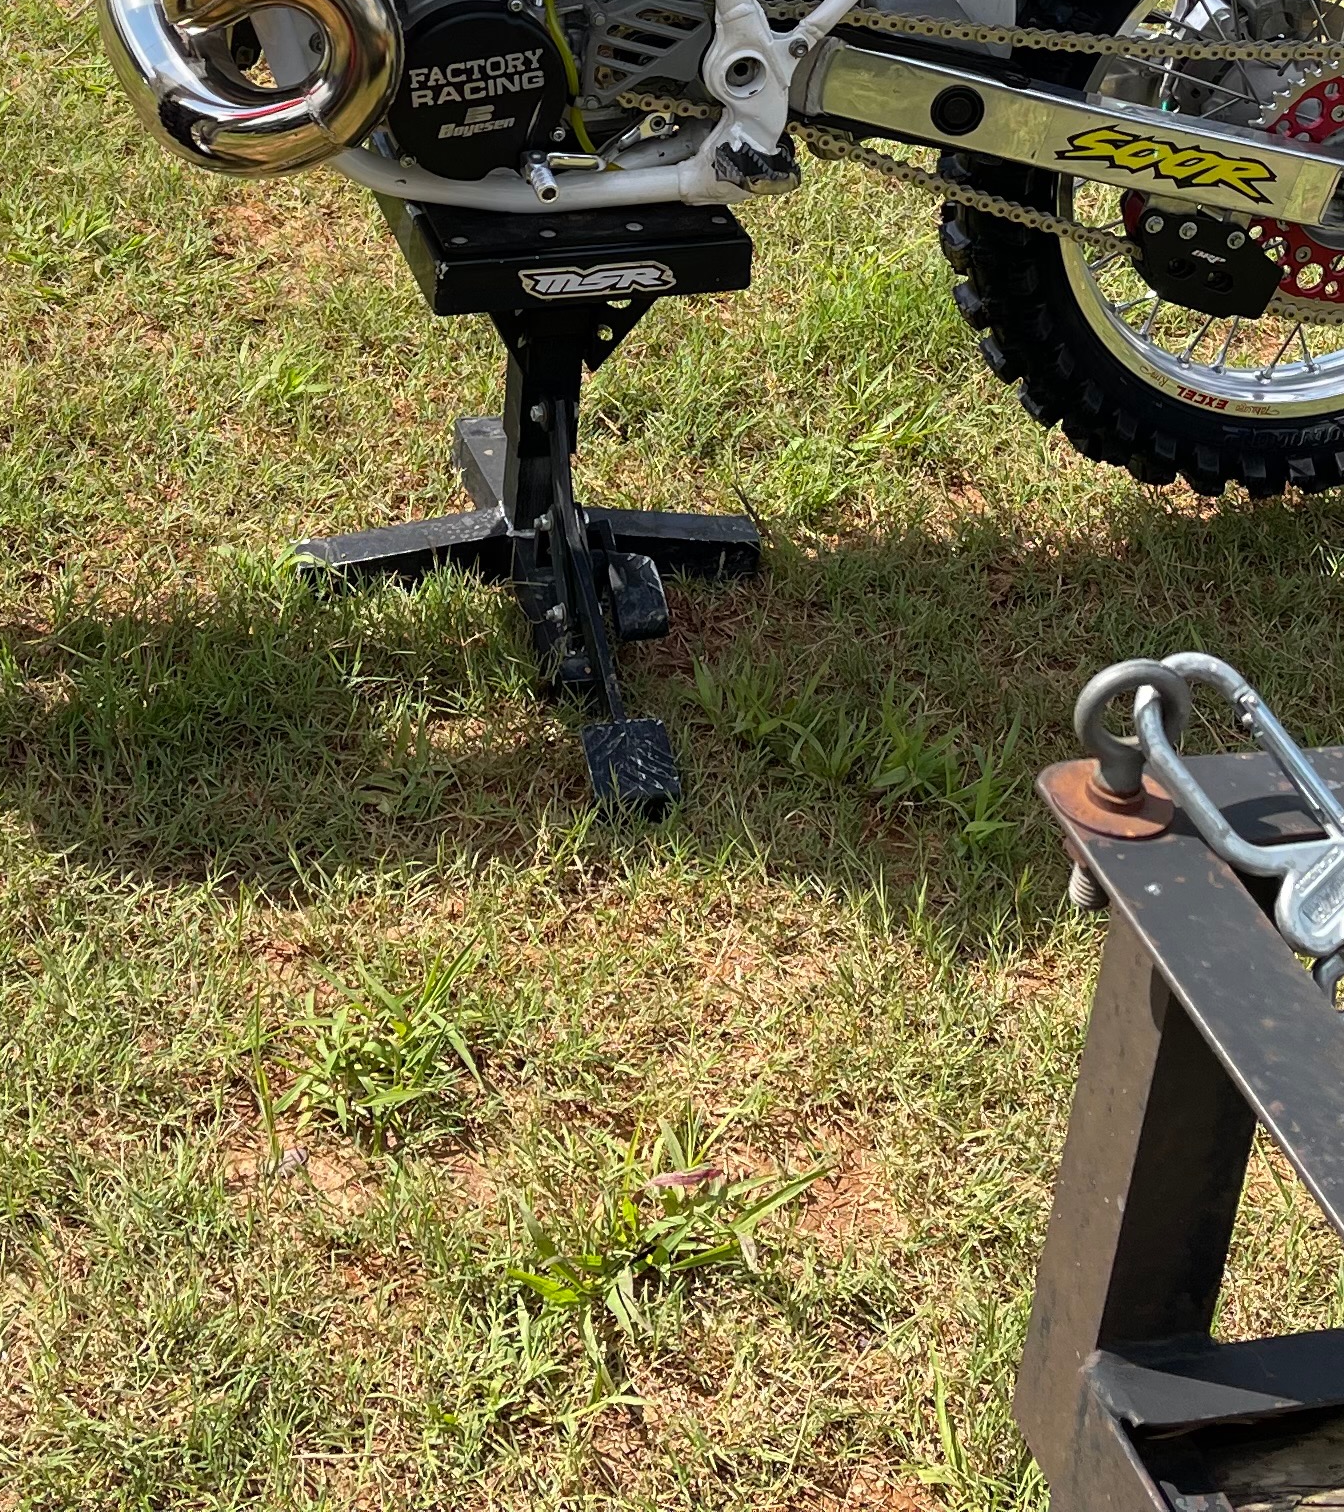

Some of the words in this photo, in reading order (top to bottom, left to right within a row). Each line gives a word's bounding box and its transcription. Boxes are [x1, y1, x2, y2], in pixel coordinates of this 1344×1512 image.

[409, 49, 544, 88] FACTORY
[411, 70, 545, 108] RACING
[438, 117, 516, 139] Boyesen
[1055, 124, 1277, 204] 500R
[532, 267, 663, 294] MSR
[1176, 385, 1229, 410] EXCEL
